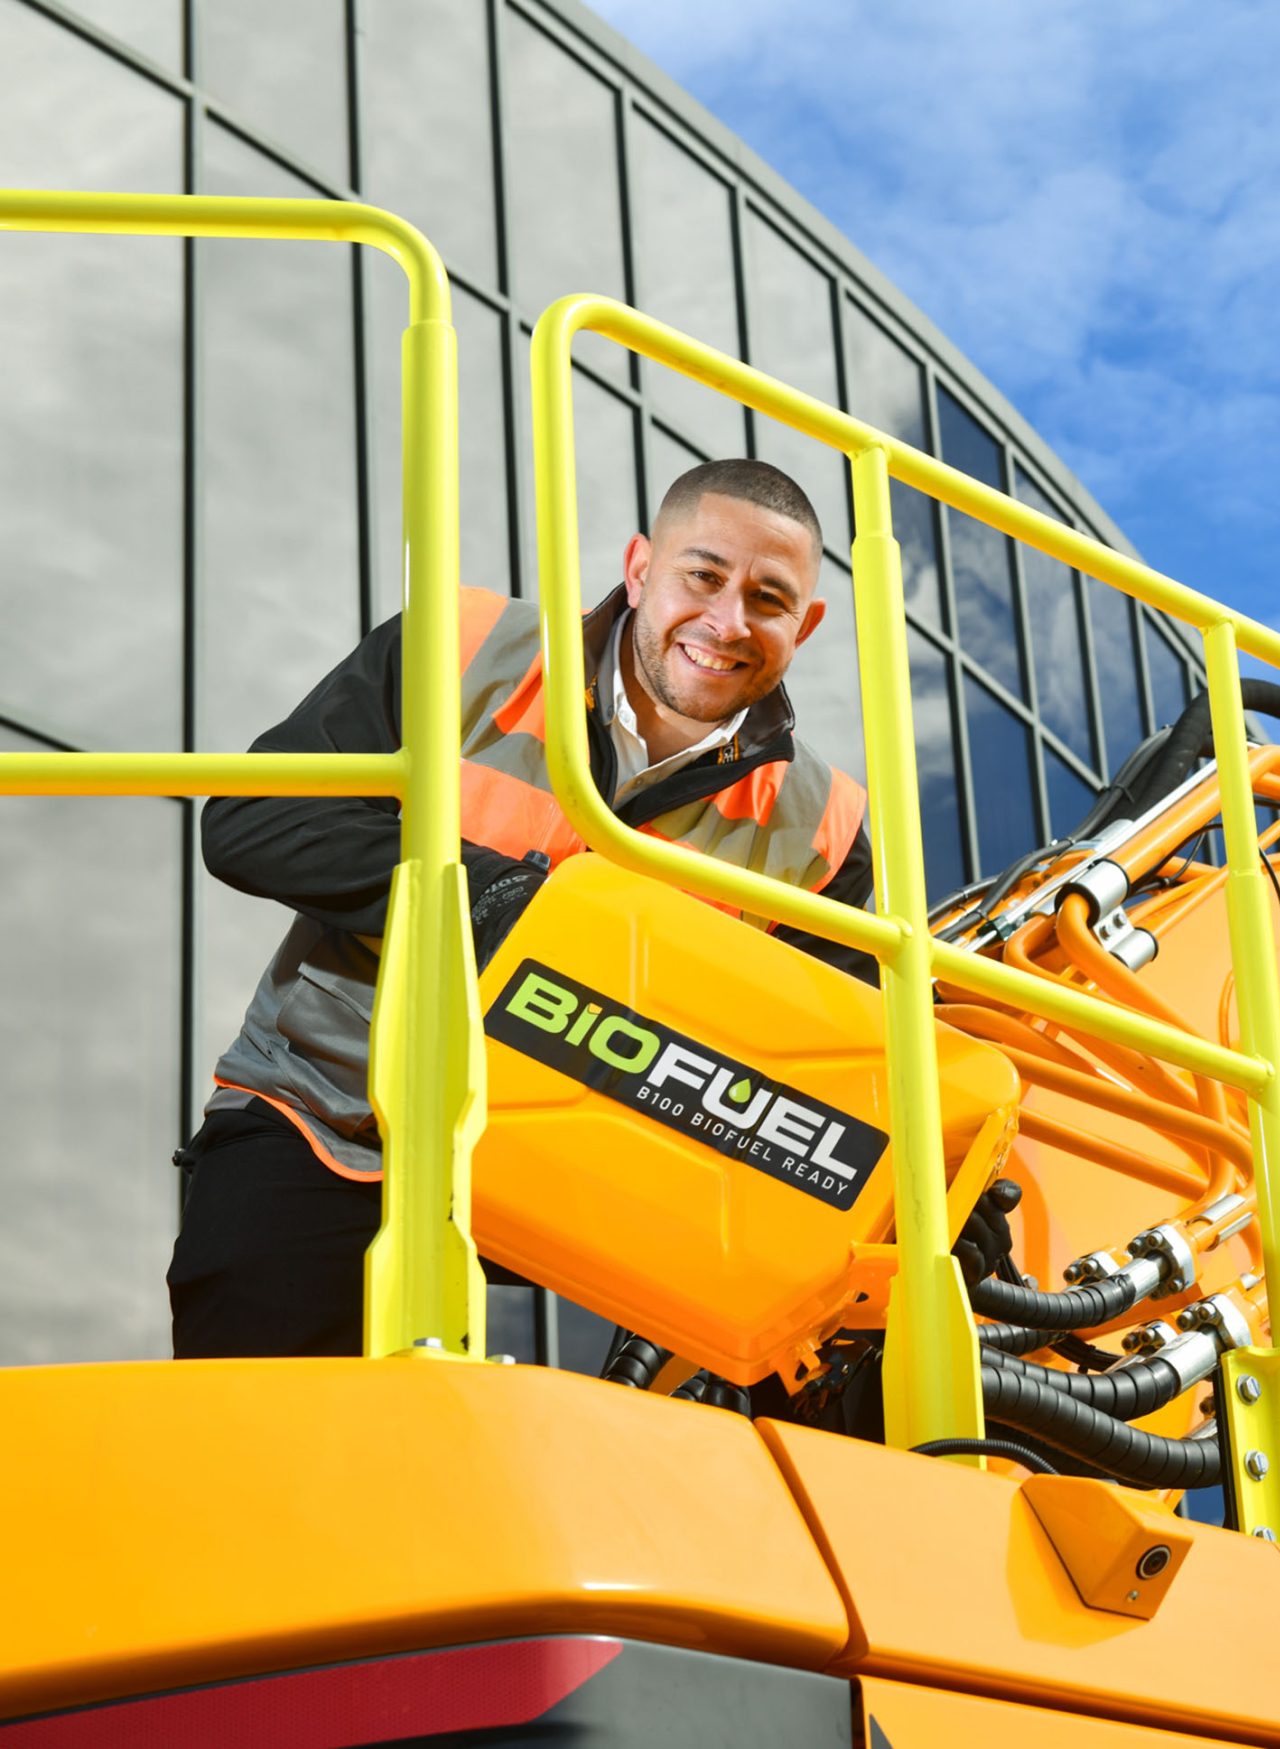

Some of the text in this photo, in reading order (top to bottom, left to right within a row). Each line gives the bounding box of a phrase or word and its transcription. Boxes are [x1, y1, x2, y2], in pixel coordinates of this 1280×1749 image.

[636, 1086, 849, 1196] B100 BIOFUEL READY
